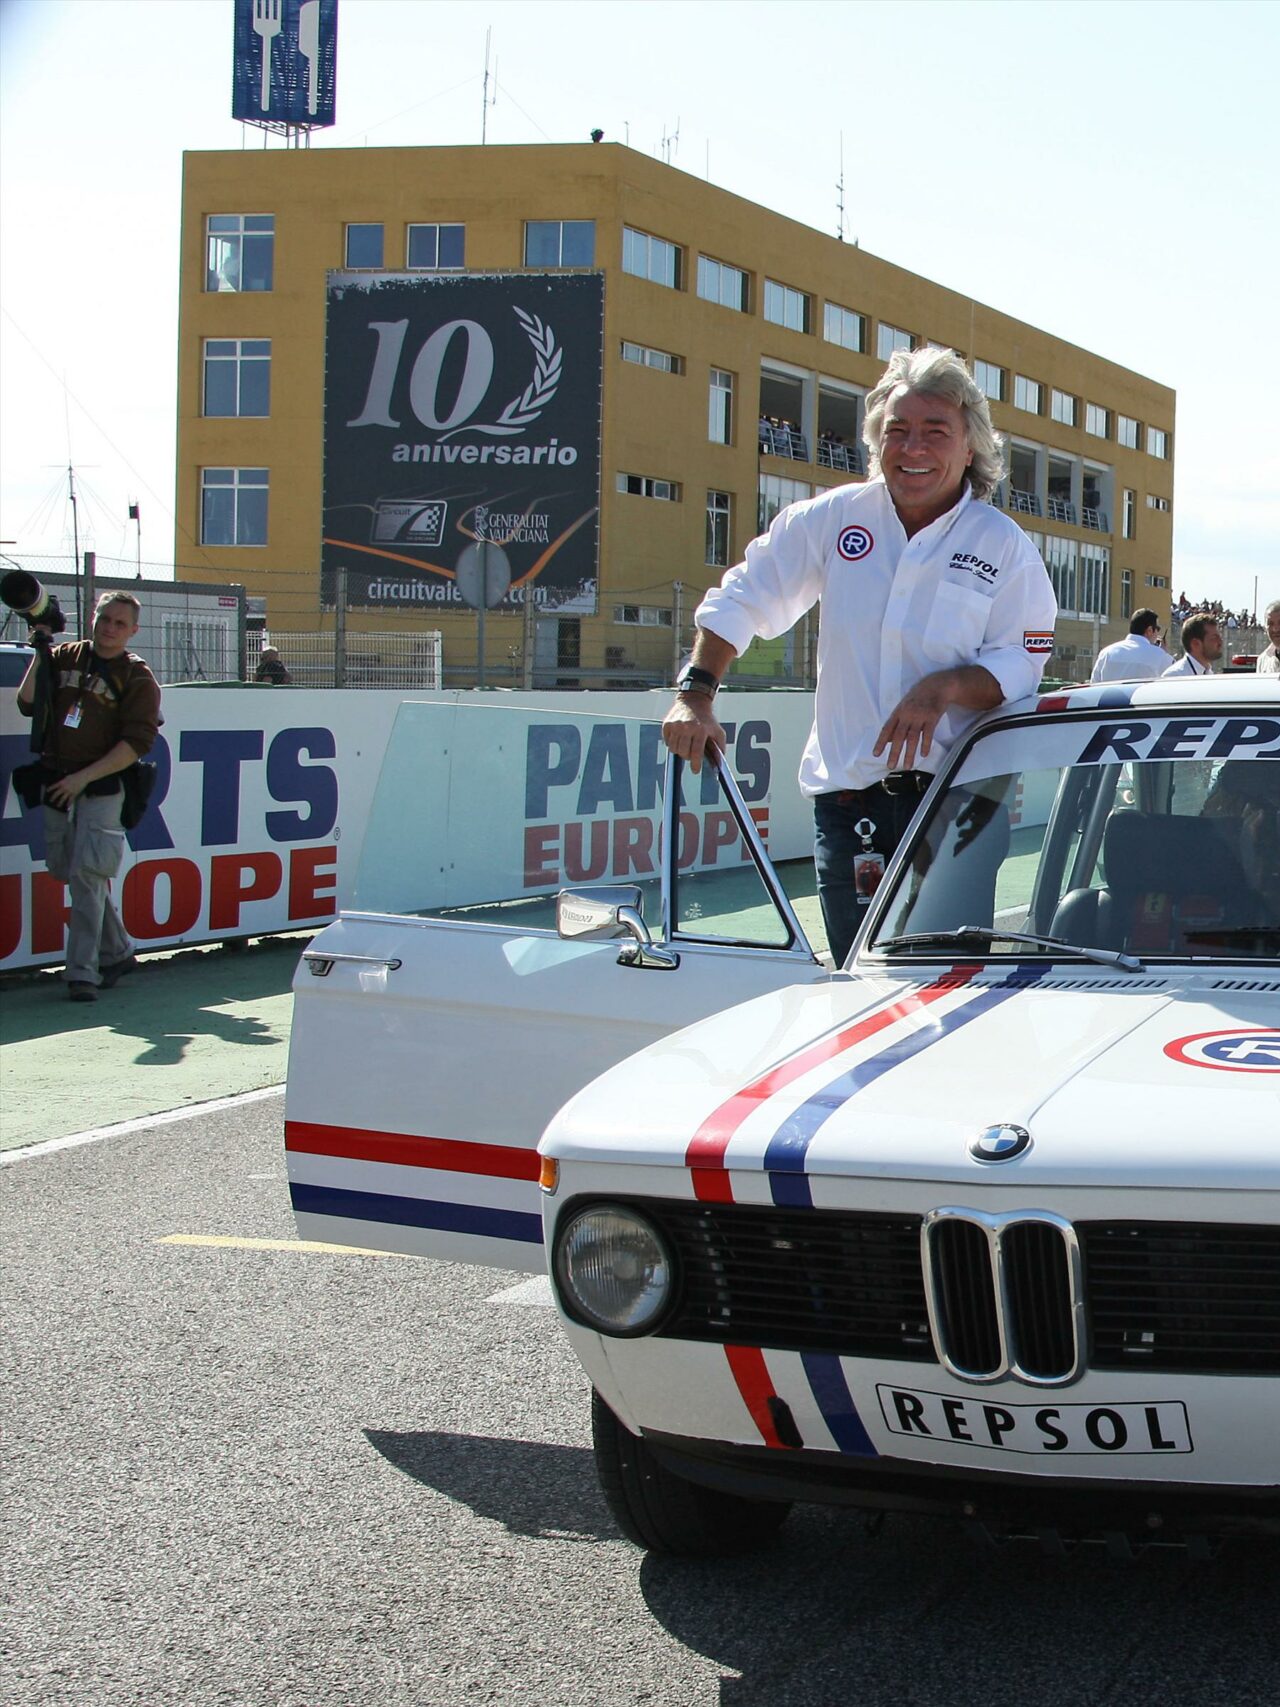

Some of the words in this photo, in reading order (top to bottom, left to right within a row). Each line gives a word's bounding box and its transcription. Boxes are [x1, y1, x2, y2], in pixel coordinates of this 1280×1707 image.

[346, 318, 495, 431] 10
[392, 439, 578, 466] aniversario
[489, 513, 550, 528] GENERALITAT
[489, 528, 550, 543] VALENCIANA
[951, 552, 999, 578] REPSOL
[891, 1390, 1177, 1452] REPSOL
